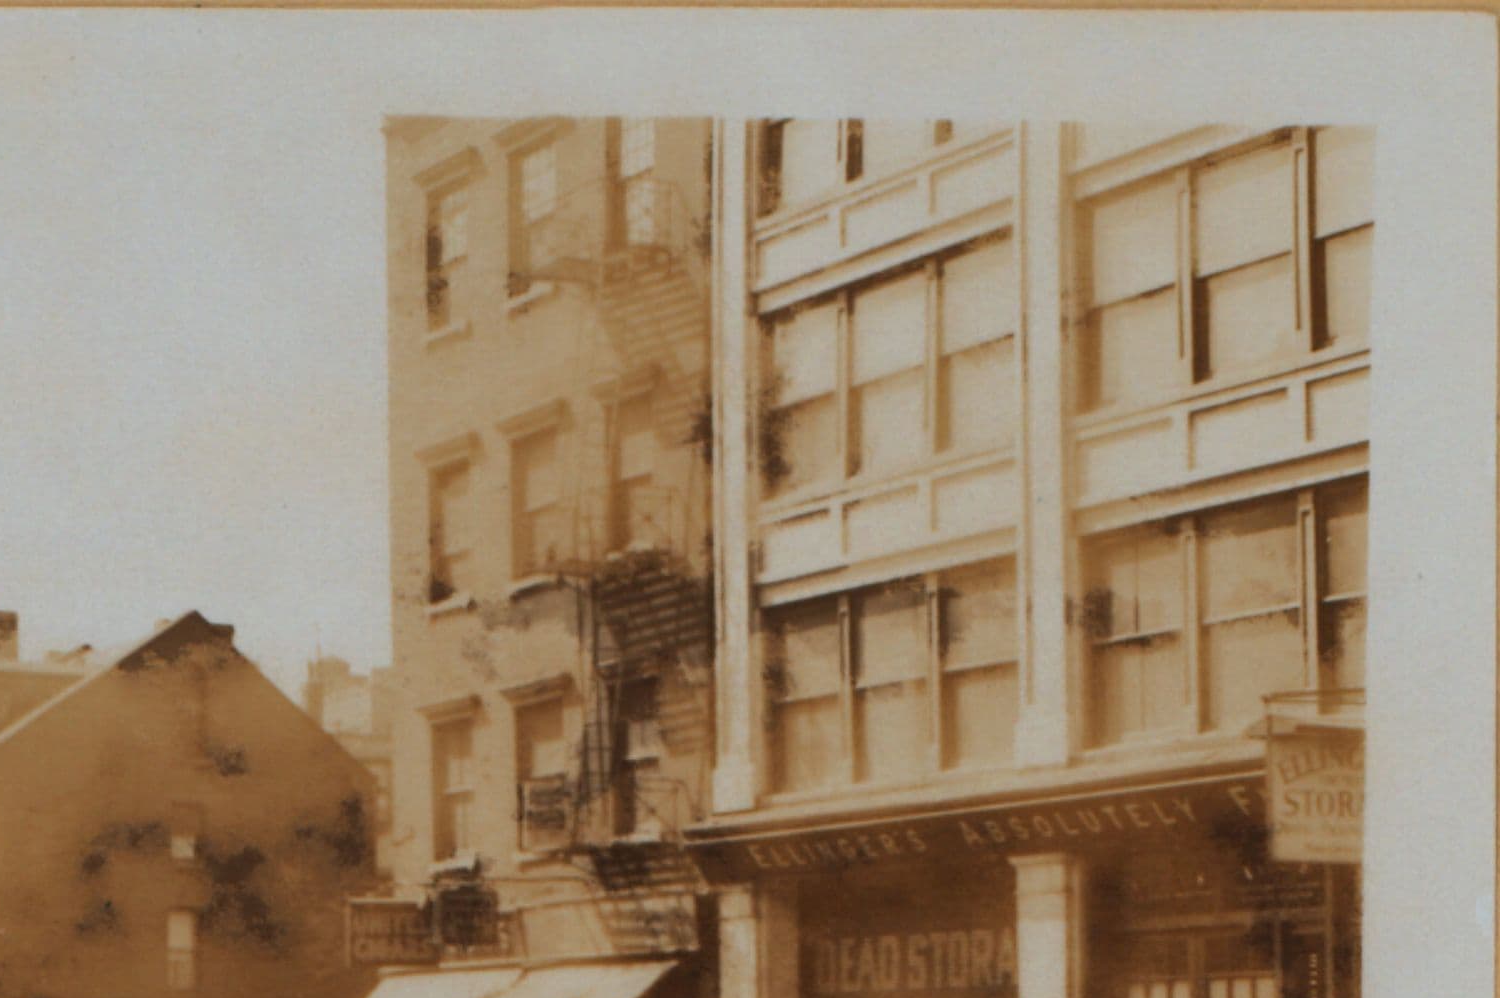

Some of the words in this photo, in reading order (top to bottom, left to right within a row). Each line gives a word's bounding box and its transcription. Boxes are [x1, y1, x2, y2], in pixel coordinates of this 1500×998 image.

[957, 795, 1198, 846] ABSOLUTELY
[1282, 790, 1364, 819] STOR
[814, 933, 900, 994] DEAD
